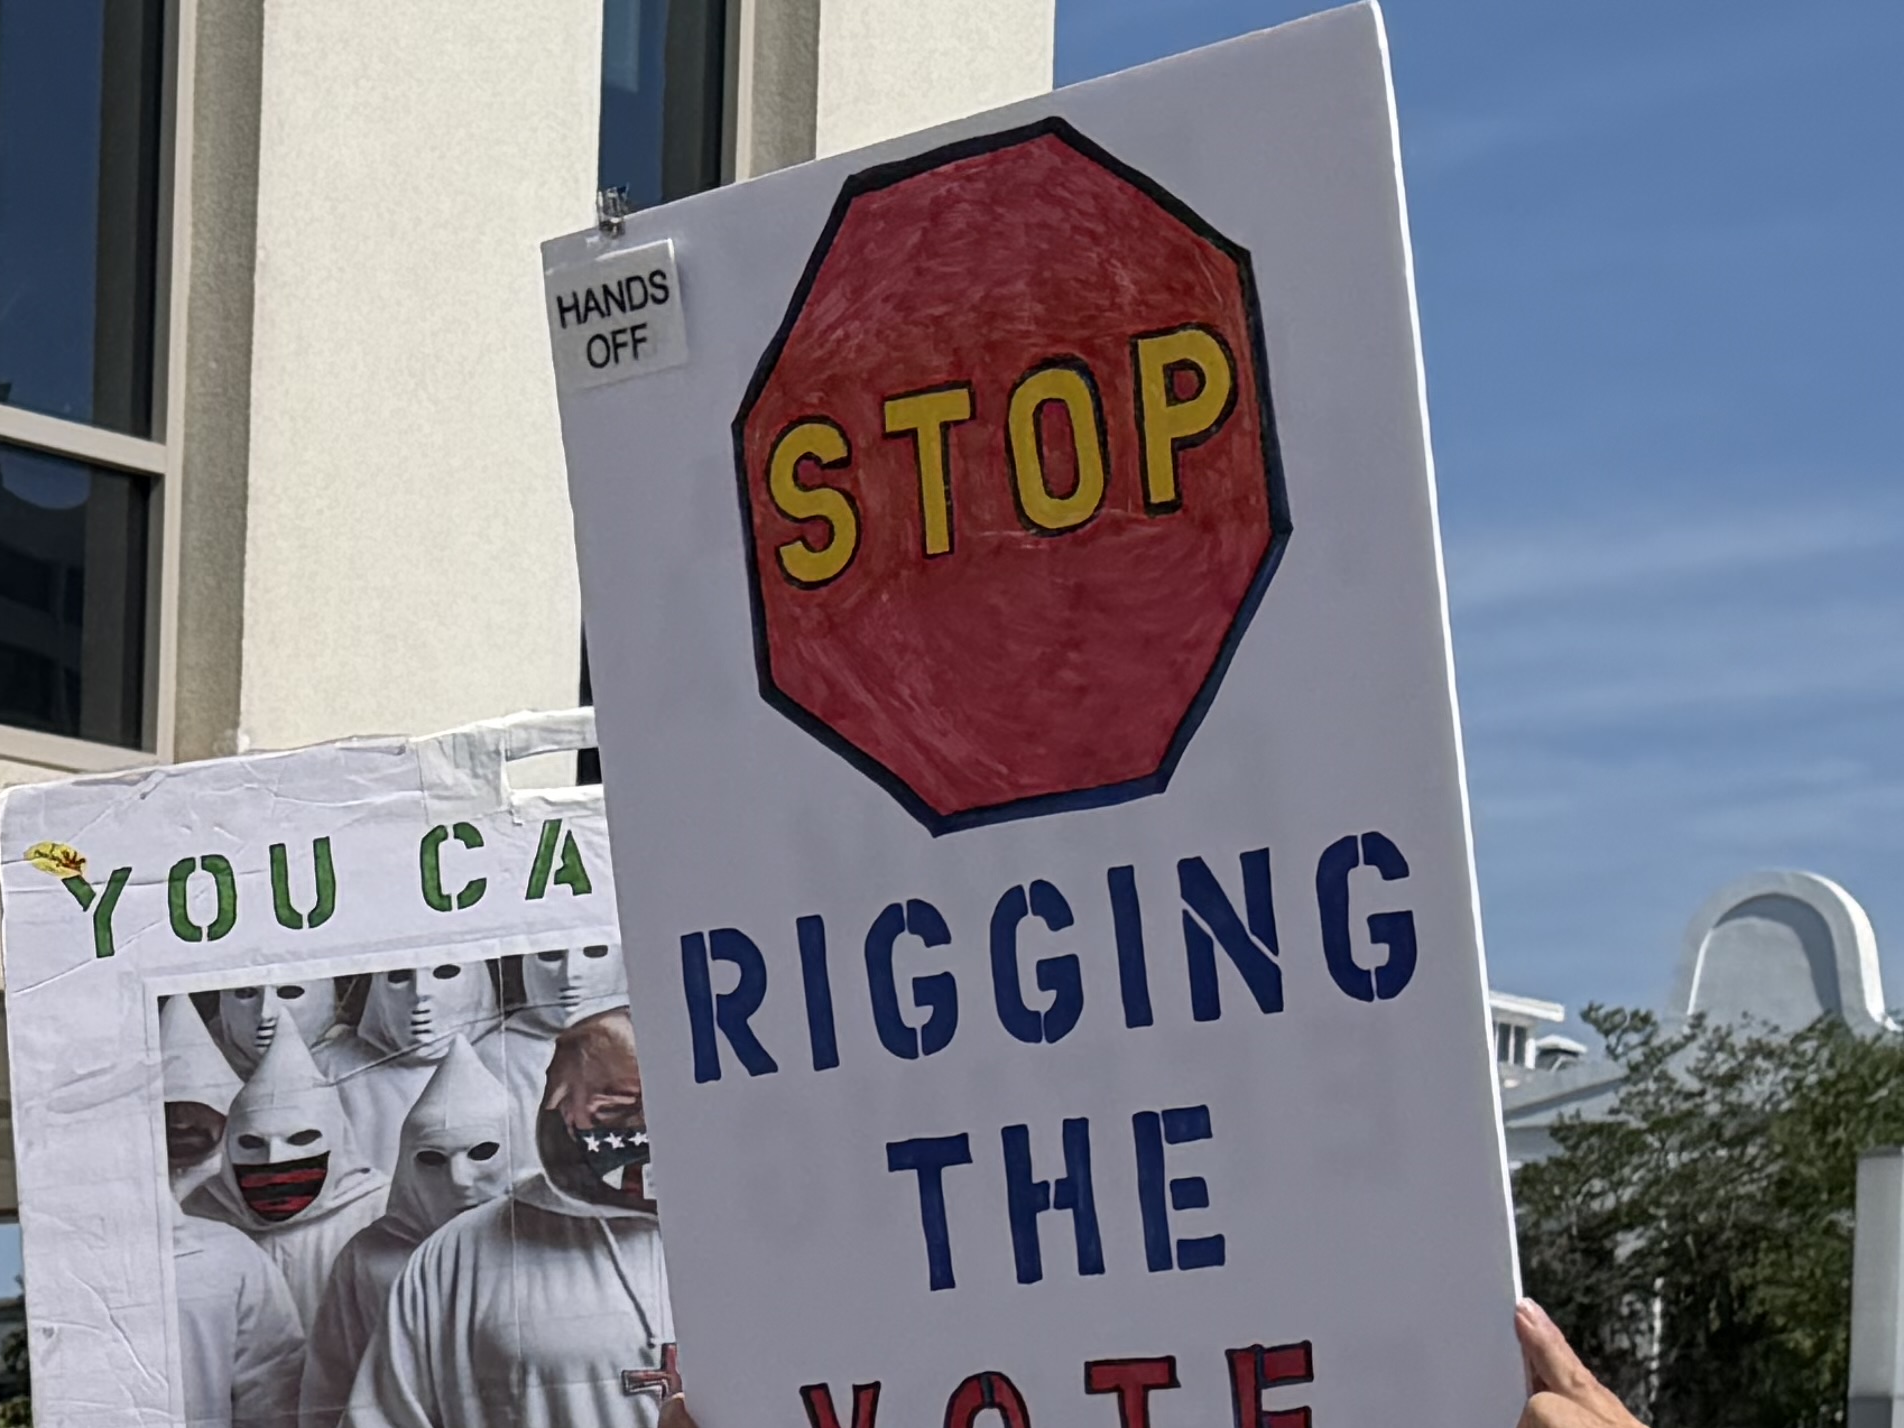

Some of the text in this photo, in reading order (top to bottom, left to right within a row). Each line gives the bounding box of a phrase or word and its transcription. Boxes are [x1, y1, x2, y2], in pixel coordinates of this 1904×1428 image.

[556, 269, 670, 330] HANDS
[586, 322, 648, 368] OFF
[766, 322, 1237, 591] STOP
[61, 836, 337, 959] YOU
[677, 828, 1419, 1086] RIGGING
[885, 1103, 1226, 1292] THE
